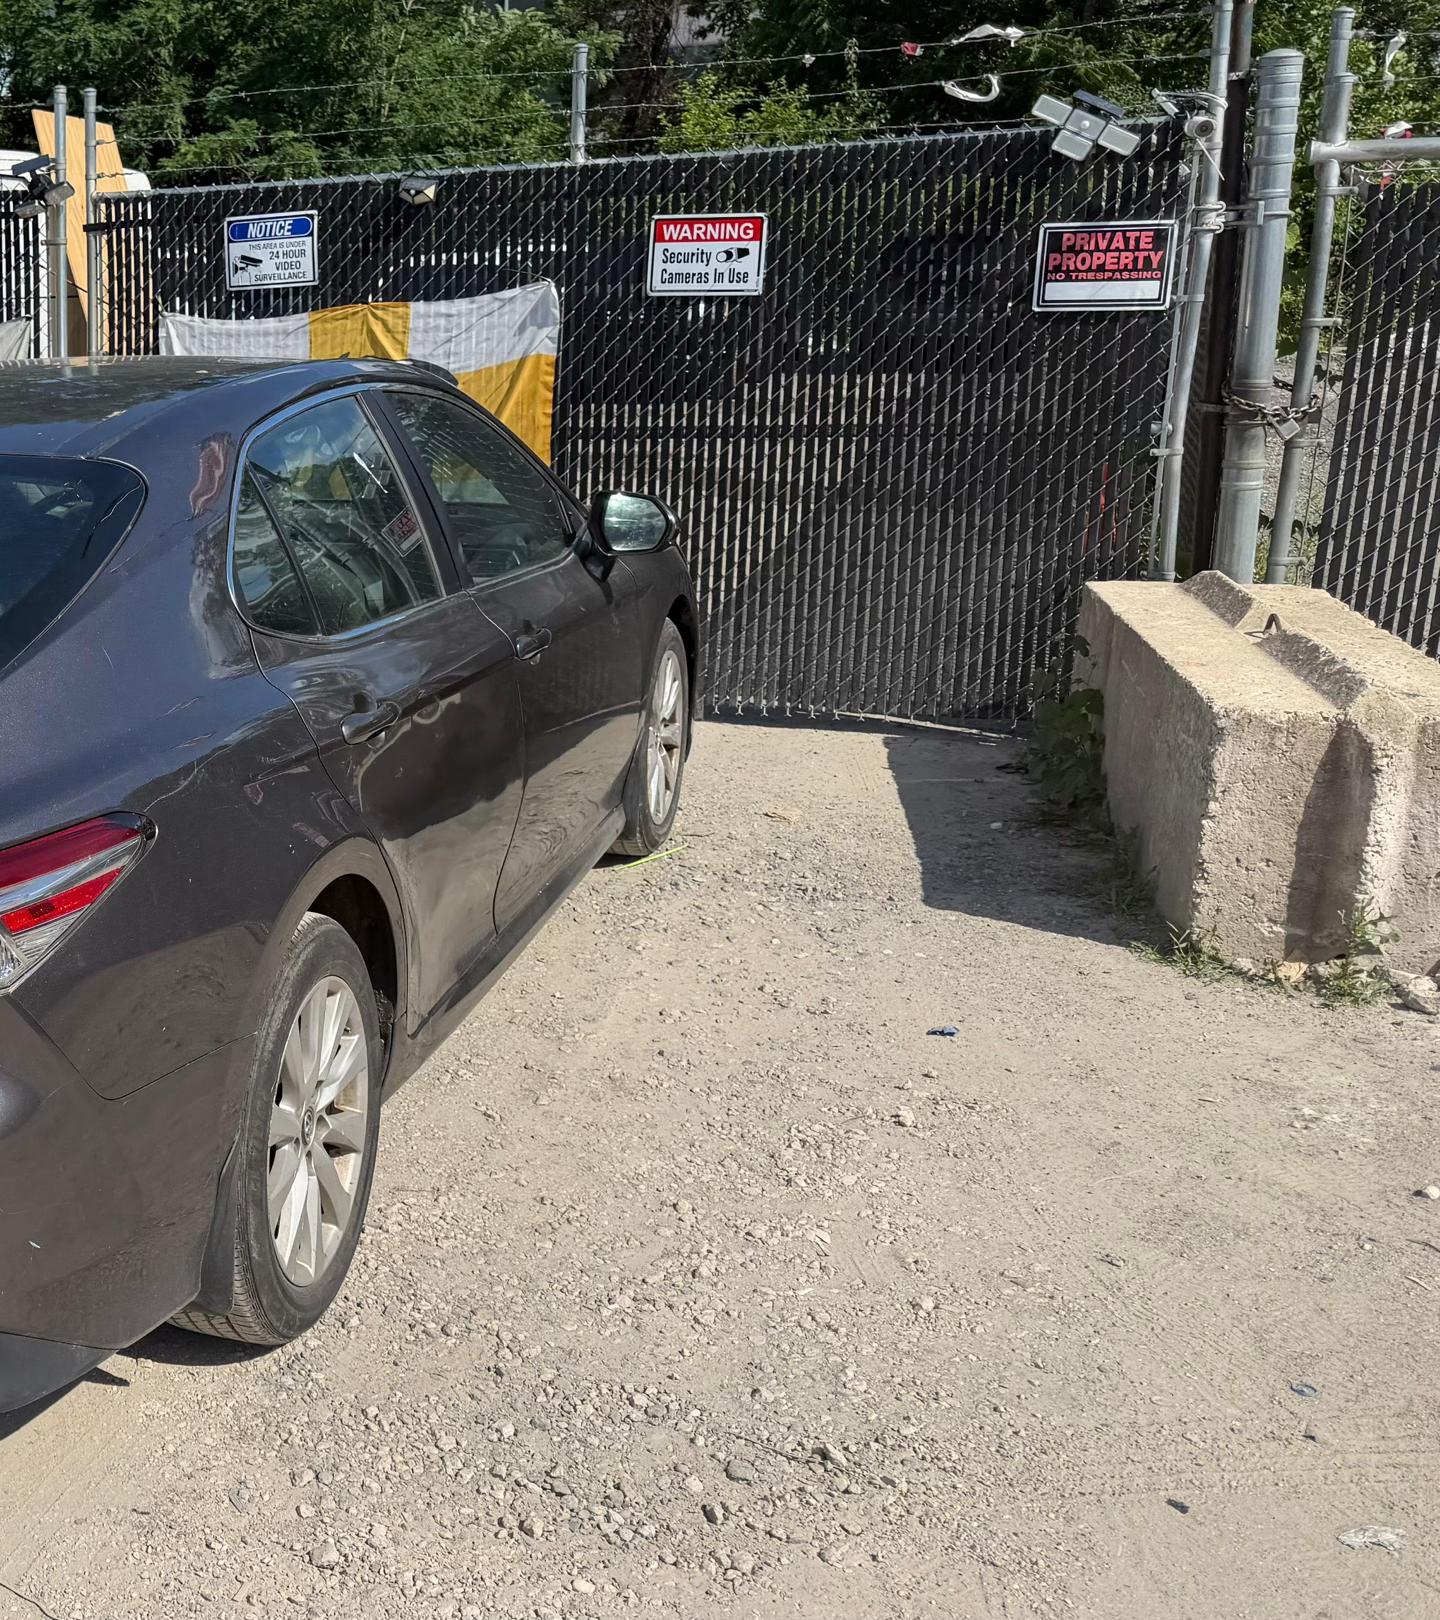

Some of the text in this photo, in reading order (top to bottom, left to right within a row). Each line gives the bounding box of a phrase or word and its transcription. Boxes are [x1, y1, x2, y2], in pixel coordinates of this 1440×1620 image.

[247, 220, 293, 238] NOTICE
[662, 222, 754, 241] WARNING
[248, 240, 307, 251] THIS AREA IS UNDER
[1061, 231, 1154, 251] PRIVATE
[269, 248, 307, 260] 24 HOUR
[662, 247, 712, 267] Security
[1048, 251, 1164, 271] PROPERTY
[275, 260, 301, 271] VIDEO
[254, 271, 308, 282] SURVEILLANCE
[660, 267, 749, 284] Cameras In Use
[1047, 271, 1162, 281] NO TRESPASSING
